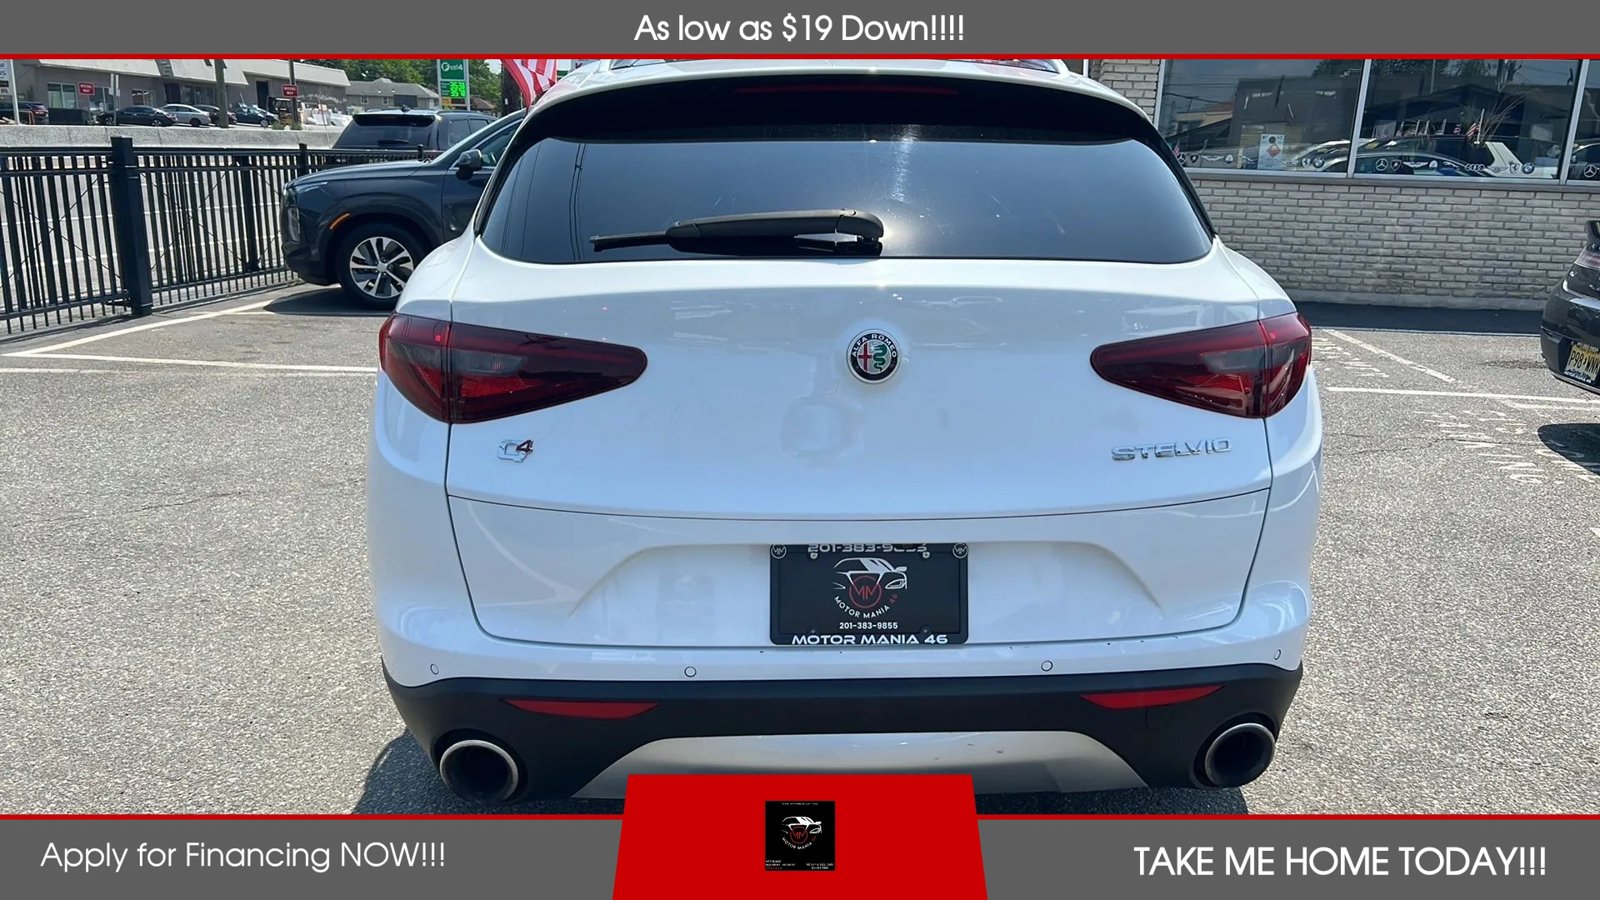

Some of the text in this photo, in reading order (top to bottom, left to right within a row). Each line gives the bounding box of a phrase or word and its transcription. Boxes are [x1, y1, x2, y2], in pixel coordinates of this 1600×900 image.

[851, 333, 897, 358] ALFA ROMEO
[1111, 437, 1233, 461] STELVIO
[833, 596, 861, 618] MOTOR
[863, 604, 890, 619] MANIA
[839, 621, 899, 630] 201-383-9855
[791, 634, 948, 645] MOTOR MANIA 46
